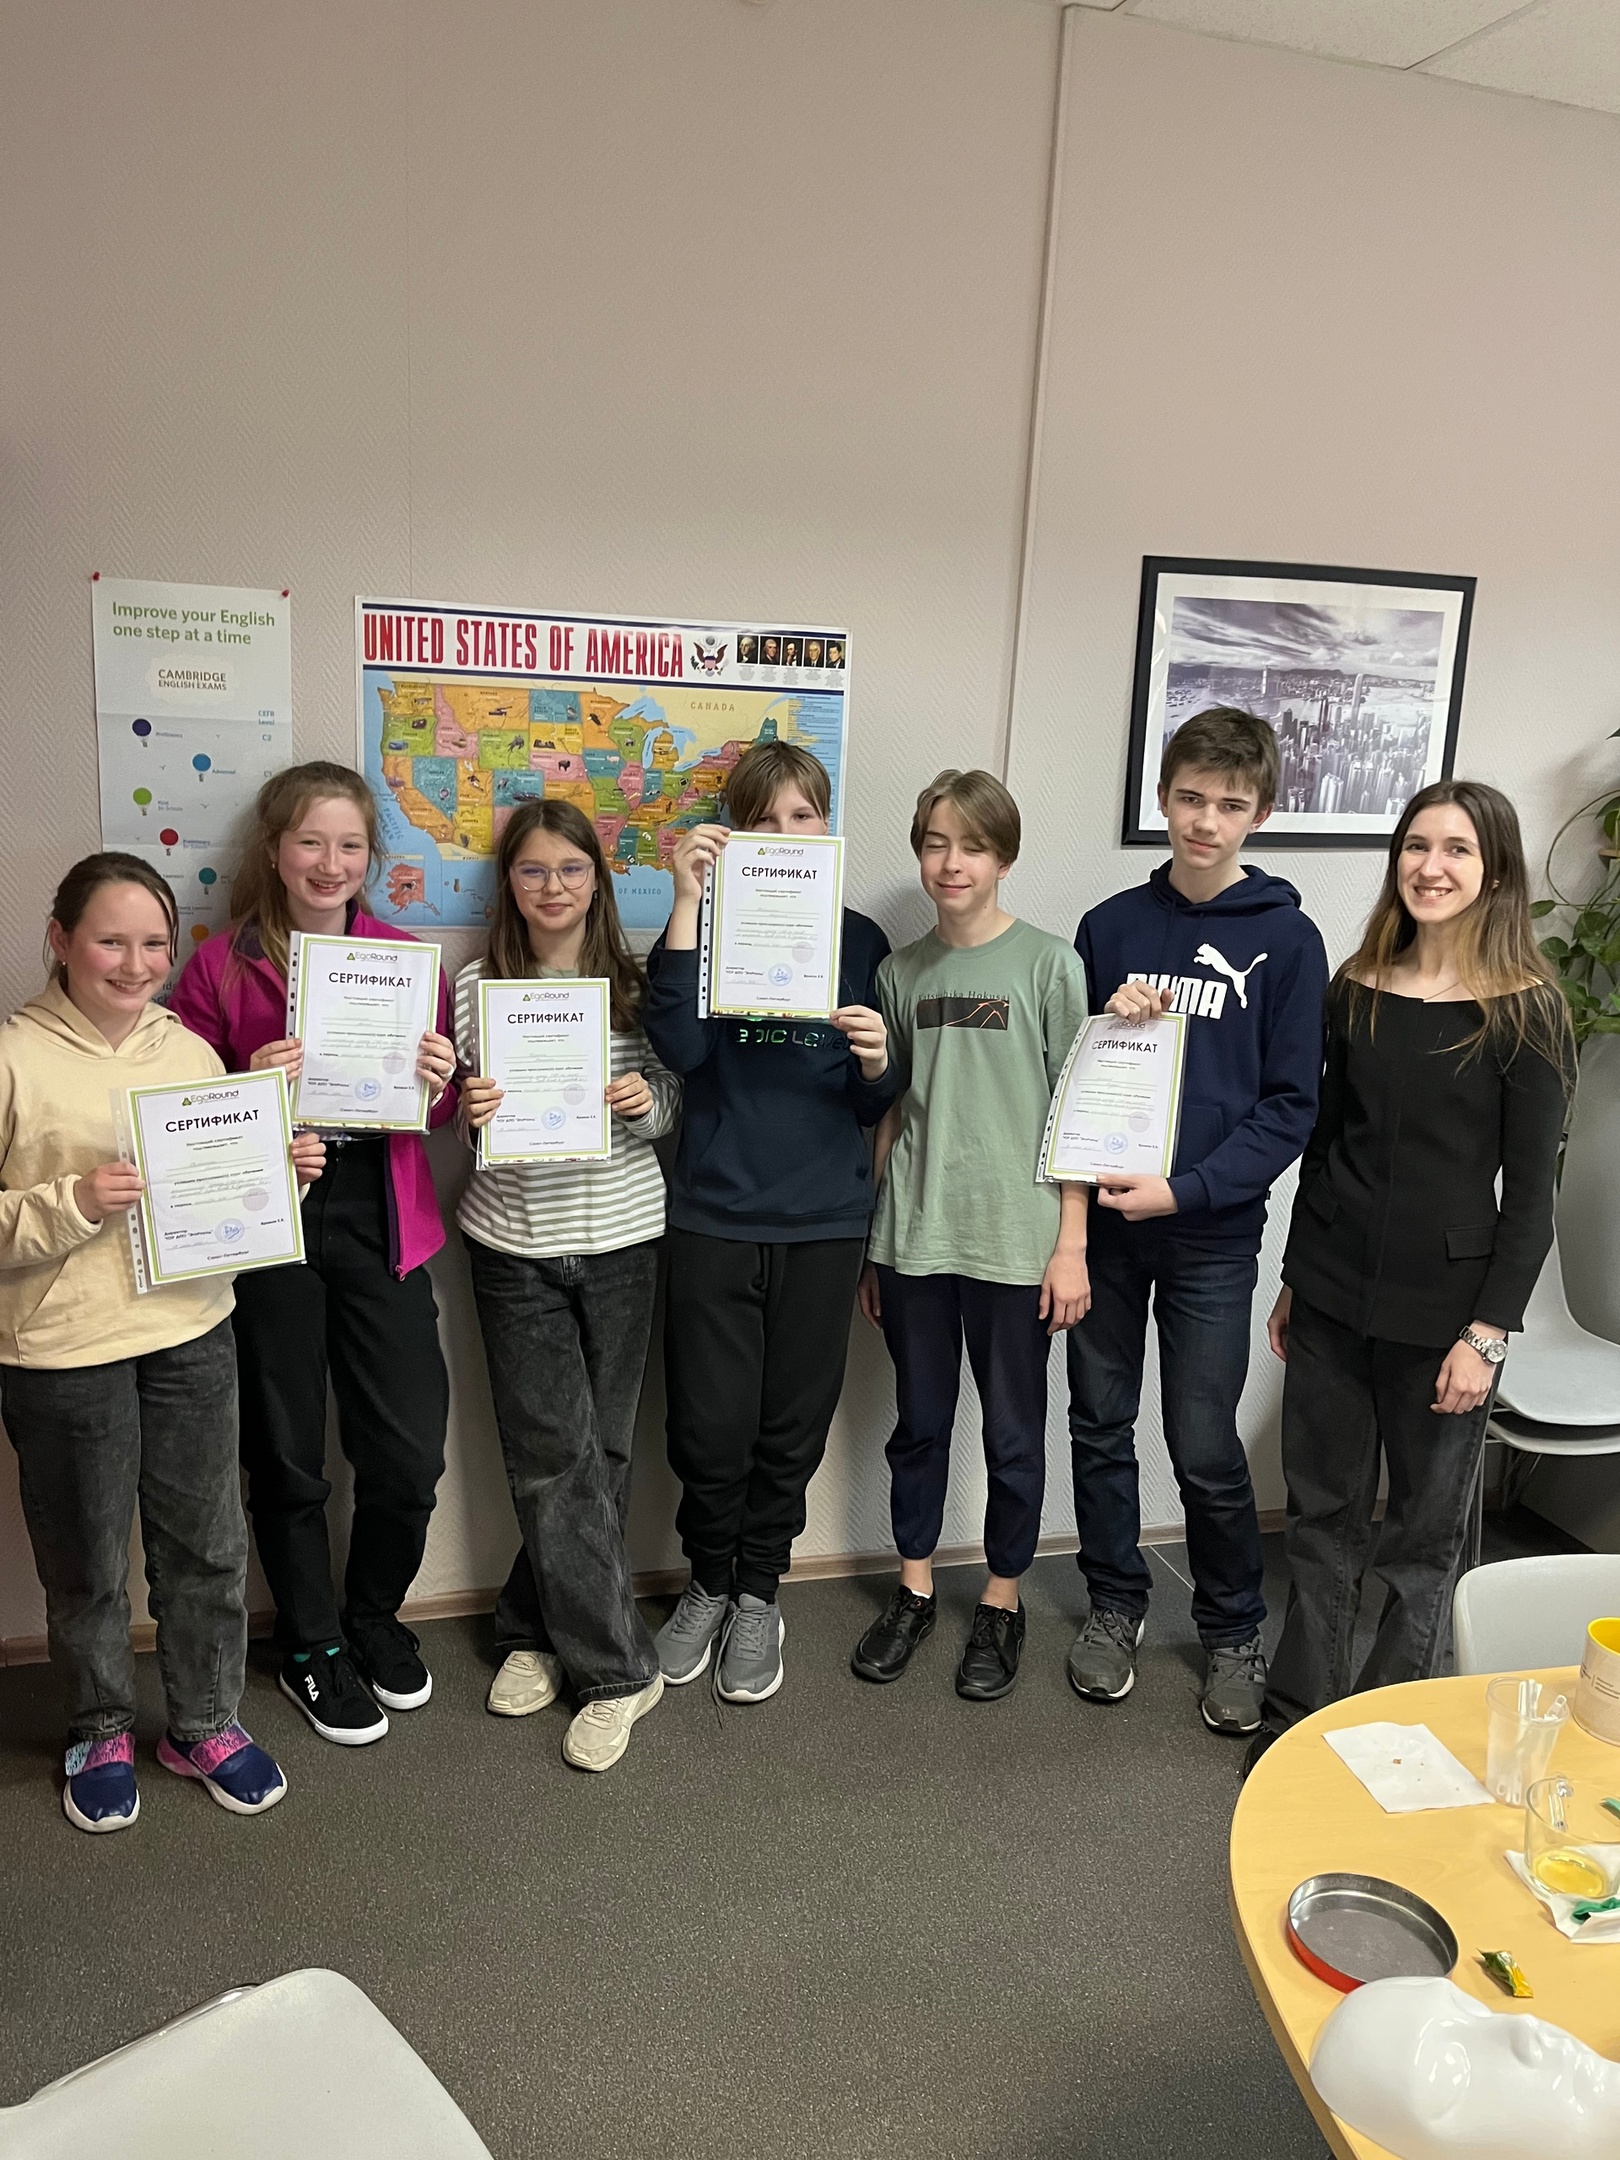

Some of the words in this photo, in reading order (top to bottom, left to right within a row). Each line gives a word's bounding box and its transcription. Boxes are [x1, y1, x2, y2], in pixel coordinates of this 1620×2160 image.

[112, 602, 177, 620] Improve
[182, 610, 216, 624] your
[220, 610, 275, 627] English
[113, 625, 142, 637] one
[147, 626, 180, 643] step
[185, 629, 200, 641] at
[204, 631, 213, 642] a
[217, 629, 252, 645] time
[363, 613, 444, 664] UNITED
[456, 619, 537, 670] STATES
[549, 625, 574, 671] OF
[586, 628, 683, 678] AMERICA
[158, 669, 226, 682] CAMBRIDGE
[158, 680, 195, 689] ENGLISH
[196, 682, 227, 691] EXAMS
[690, 701, 735, 712] CANADA
[741, 866, 818, 880] СЕРТИФИКАТ
[632, 887, 662, 895] MEXICO
[328, 972, 412, 988] СЕРТИФИКАТ
[507, 1012, 585, 1024] СЕРТИФИКАТ
[1092, 1039, 1158, 1053] СЕРТИФИКАТ
[165, 1109, 260, 1133] СЕРТИФИКАТ
[304, 1674, 320, 1702] FILA
